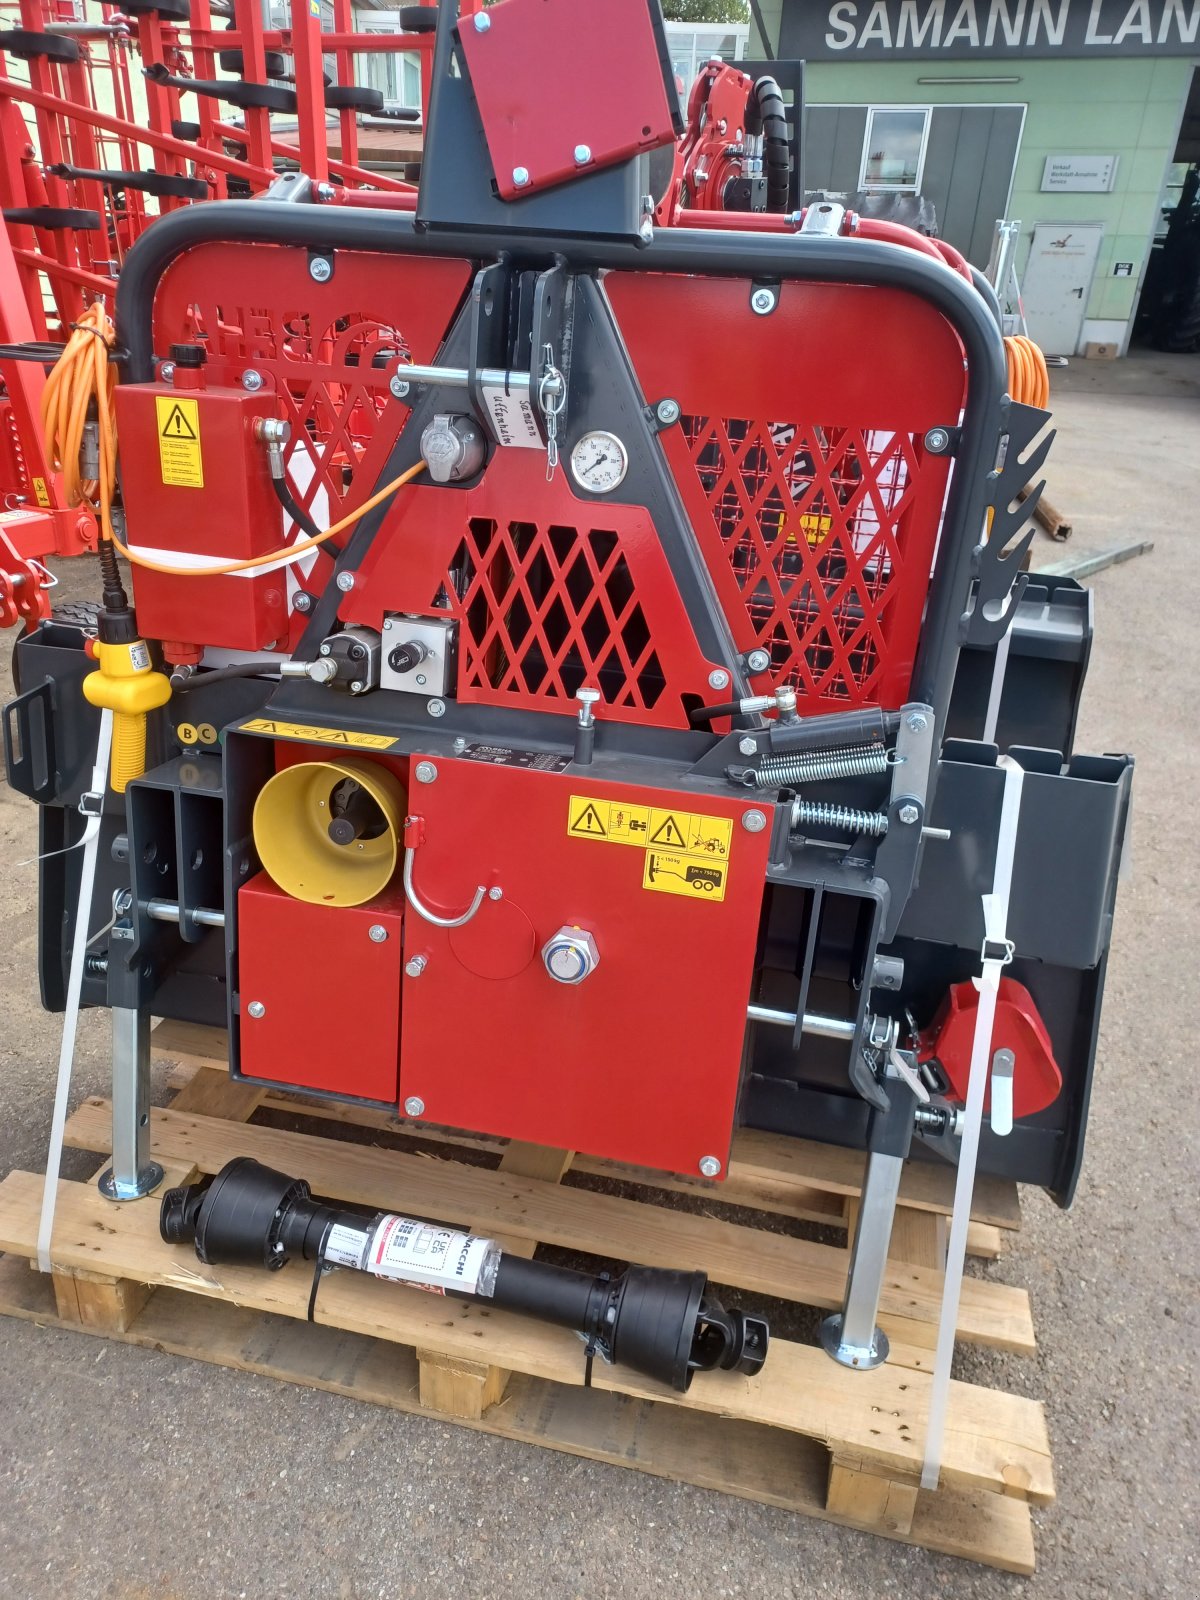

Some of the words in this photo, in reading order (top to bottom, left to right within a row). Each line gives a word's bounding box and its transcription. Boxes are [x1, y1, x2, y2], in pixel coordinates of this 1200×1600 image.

[825, 0, 1070, 50] SAMANN
[183, 728, 192, 739] B
[201, 728, 211, 740] C
